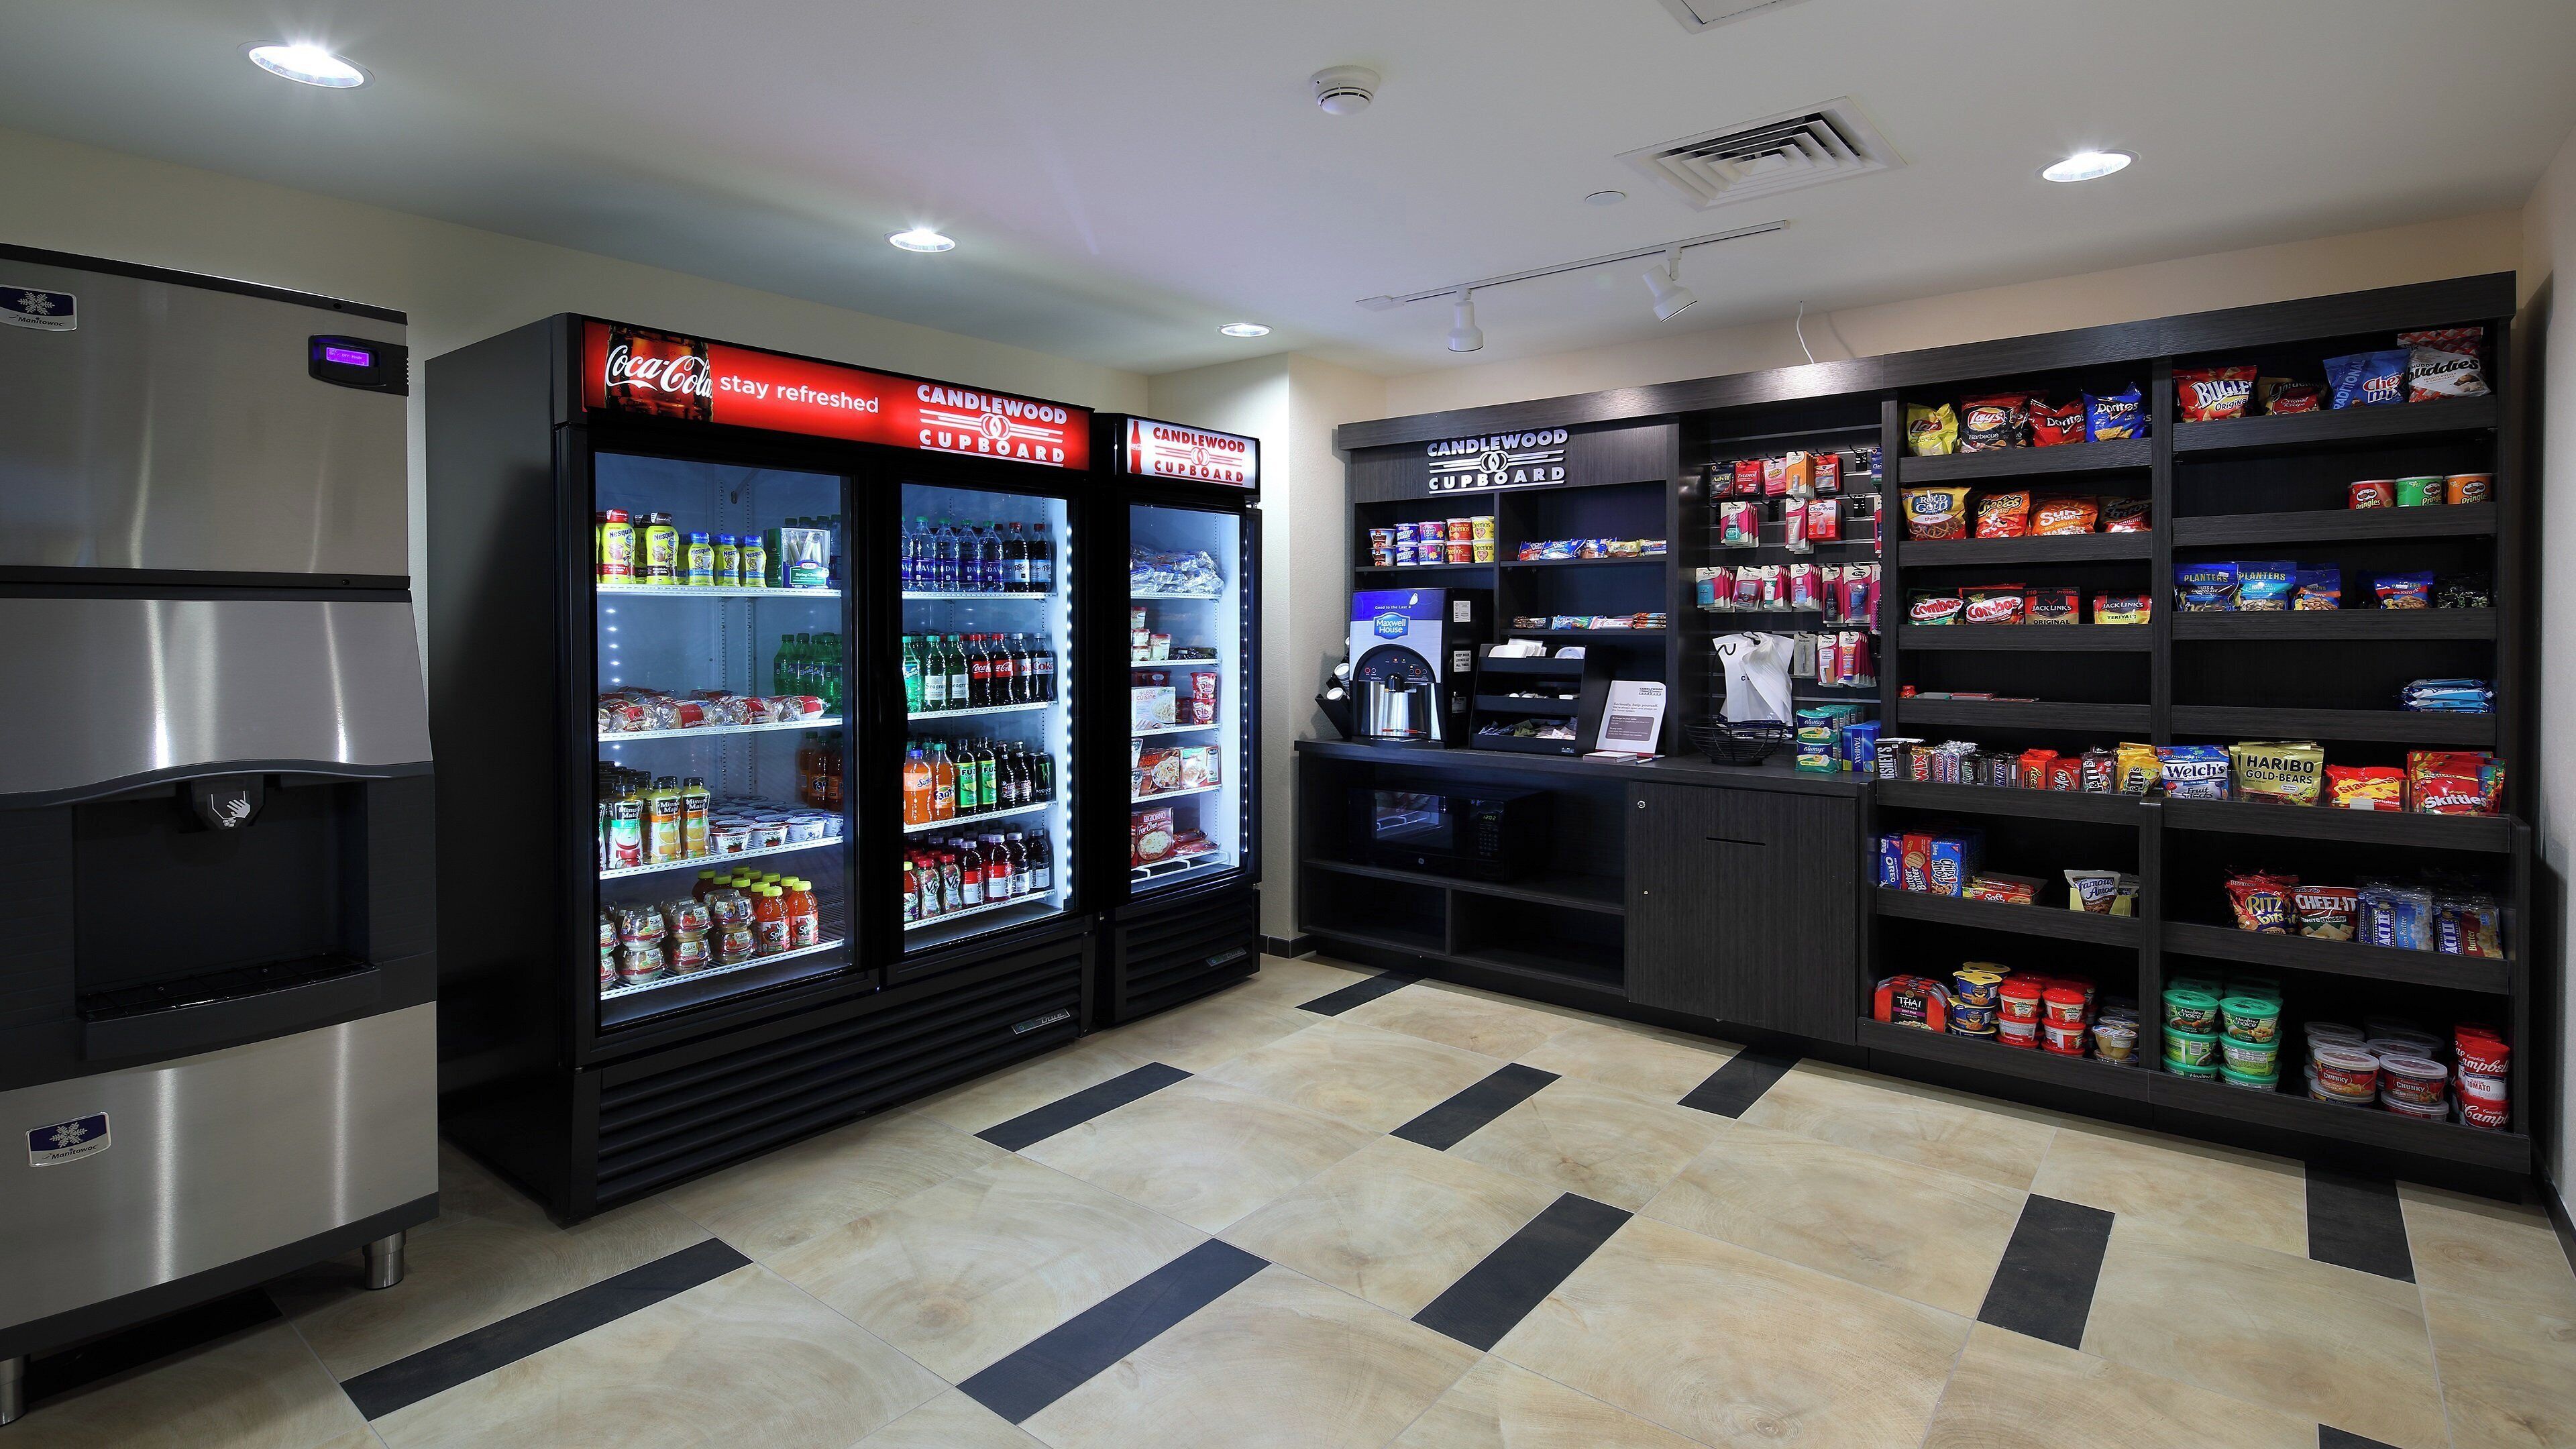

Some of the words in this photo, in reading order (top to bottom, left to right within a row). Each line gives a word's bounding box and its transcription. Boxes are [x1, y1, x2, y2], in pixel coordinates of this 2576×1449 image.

[18, 317, 64, 327] Manitowoc
[605, 345, 713, 399] Coca-Cola
[720, 374, 770, 398] stay
[777, 385, 879, 413] refreshed
[917, 385, 1067, 425] CANDLEWOOD
[2096, 402, 2139, 413] Doritos
[1153, 427, 1246, 453] CANDLEWOOD
[1969, 432, 1999, 440] Barbecue
[919, 429, 1065, 464] CUPBOARD
[1427, 429, 1568, 457] CANDLEWOOD
[1155, 460, 1243, 482] CUPBOARD
[1429, 466, 1565, 490] CUPBOARD
[609, 527, 633, 539] Nesquik
[2239, 572, 2286, 582] PLANTERS
[1913, 598, 1962, 616] Combos
[1377, 619, 1406, 627] Maxwell
[1805, 718, 1825, 726] always
[1803, 746, 1825, 754] always
[2247, 755, 2314, 773] HARIBO
[2166, 763, 2228, 779] Welch's
[2246, 769, 2312, 784] GOLD-BEARS
[2187, 787, 2209, 795] Fruit
[2424, 794, 2487, 808] Skittles
[1146, 820, 1158, 832] One
[1885, 856, 1896, 883] OREO
[1939, 859, 1956, 879] Chips
[946, 877, 960, 888] V8
[1911, 867, 1927, 891] Butter
[2078, 878, 2113, 890] Famous
[925, 882, 939, 894] V8
[2086, 887, 2115, 899] Amos
[1984, 893, 2004, 902] Soft
[2247, 896, 2284, 914] RITZ
[2257, 912, 2284, 924] bits
[2400, 916, 2408, 935] Butter
[2378, 923, 2392, 947] ACT
[2468, 930, 2477, 951] Butter
[2443, 930, 2459, 954] ACT
[1897, 996, 1921, 1008] THAI
[1036, 1012, 1067, 1024] true
[2233, 1019, 2257, 1027] Choice
[2323, 1073, 2349, 1084] CHUNKY
[2396, 1082, 2425, 1093] CHUNKY
[2467, 1081, 2491, 1092] TOMATO
[52, 1144, 97, 1160] Manitowoc
